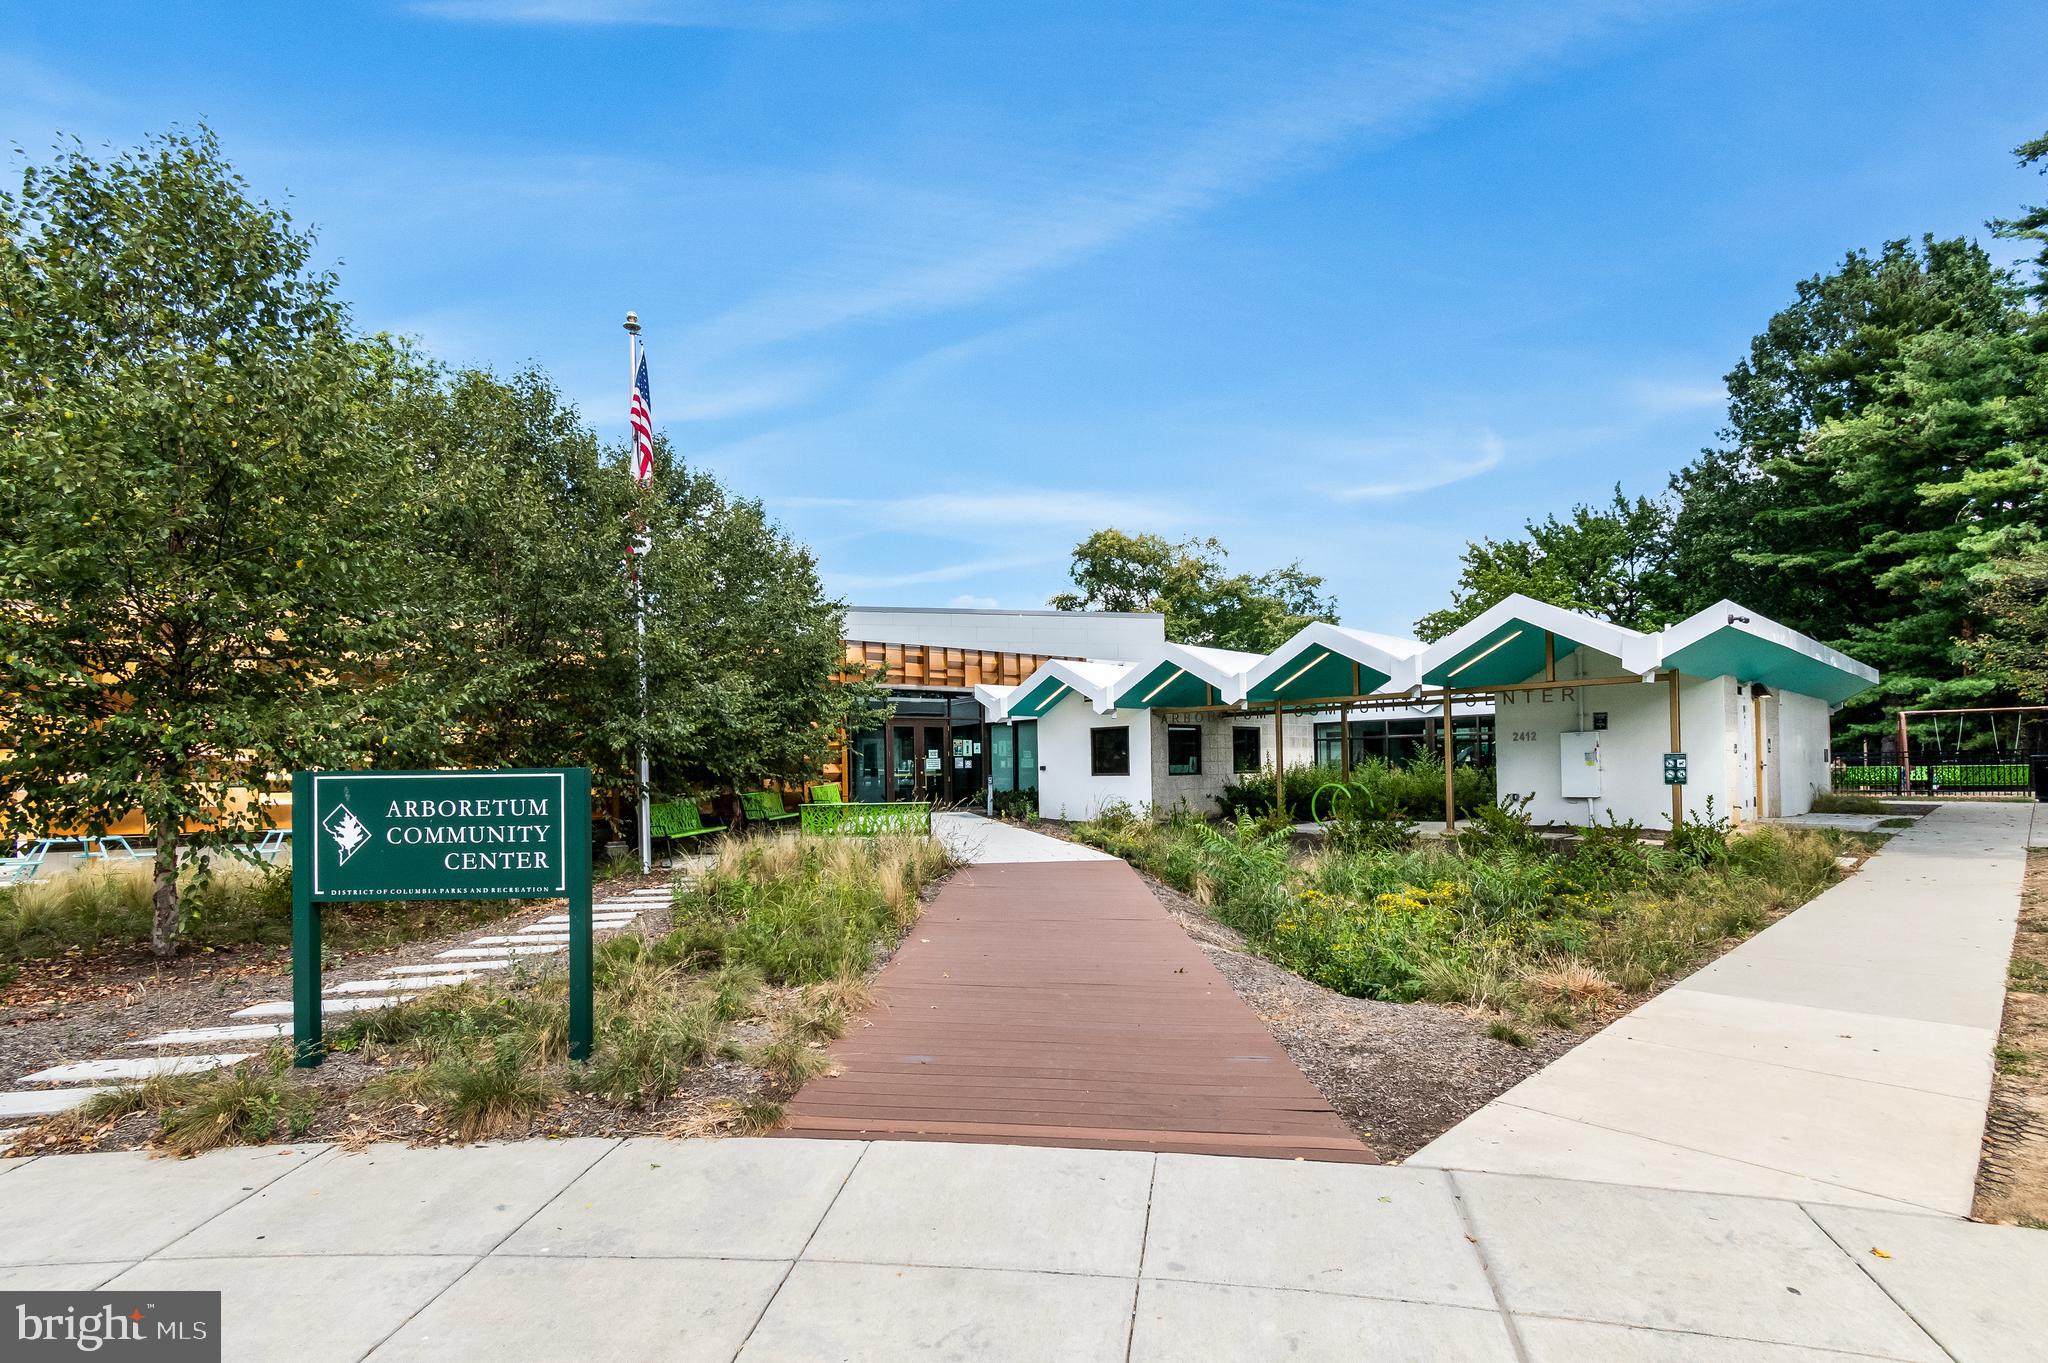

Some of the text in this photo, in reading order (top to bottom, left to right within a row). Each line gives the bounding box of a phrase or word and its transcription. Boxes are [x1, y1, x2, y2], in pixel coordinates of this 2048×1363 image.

[1161, 706, 1266, 724] ARBORTUM
[1512, 731, 1537, 742] 2412
[385, 798, 550, 818] ARBORETUM
[386, 824, 551, 845] COMMUNITY
[444, 852, 550, 871] CENTER
